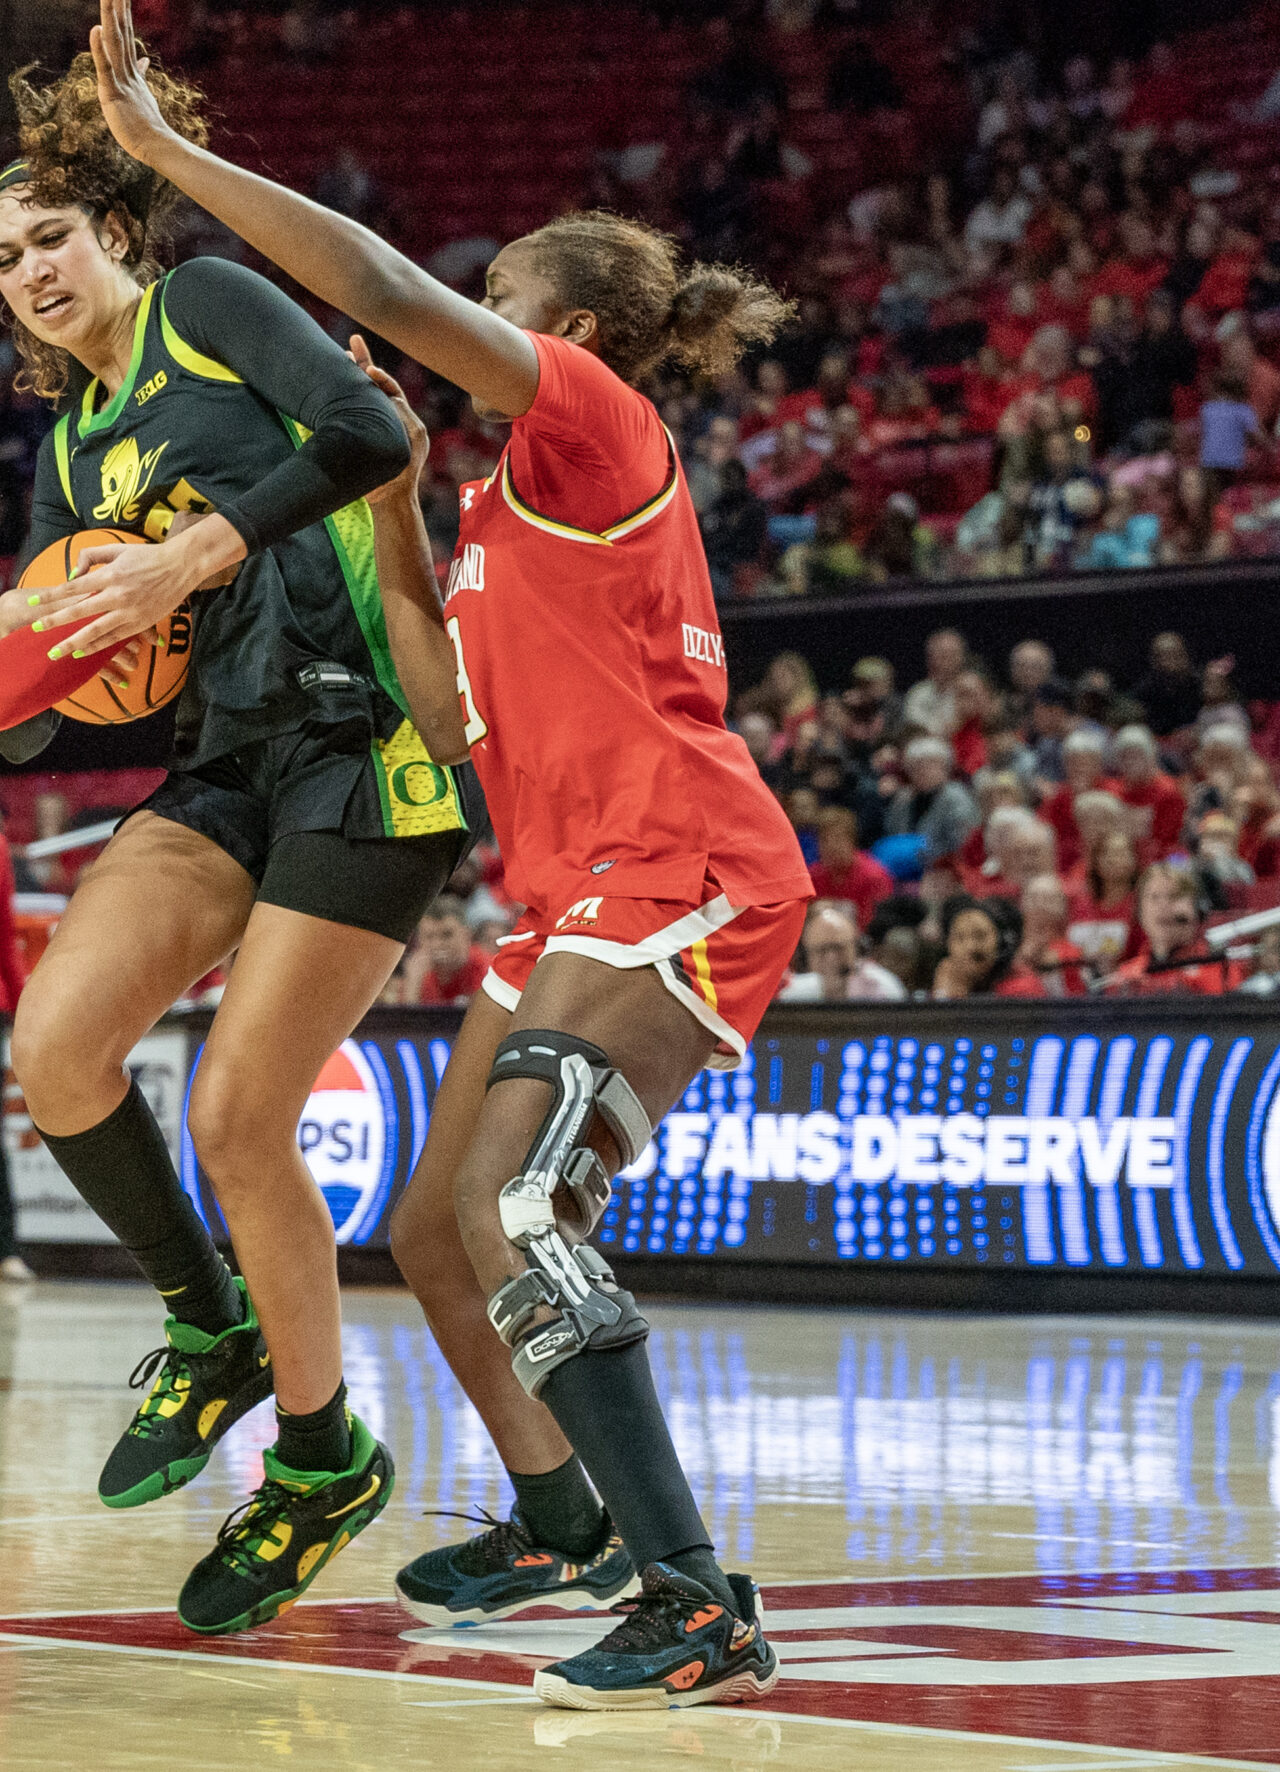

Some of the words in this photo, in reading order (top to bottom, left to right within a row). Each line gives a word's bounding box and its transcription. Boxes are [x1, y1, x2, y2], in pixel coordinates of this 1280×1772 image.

[681, 622, 727, 672] OZZY-
[300, 1119, 369, 1163] PSI
[665, 1111, 841, 1186] FANS
[850, 1112, 1176, 1189] DESERVE
